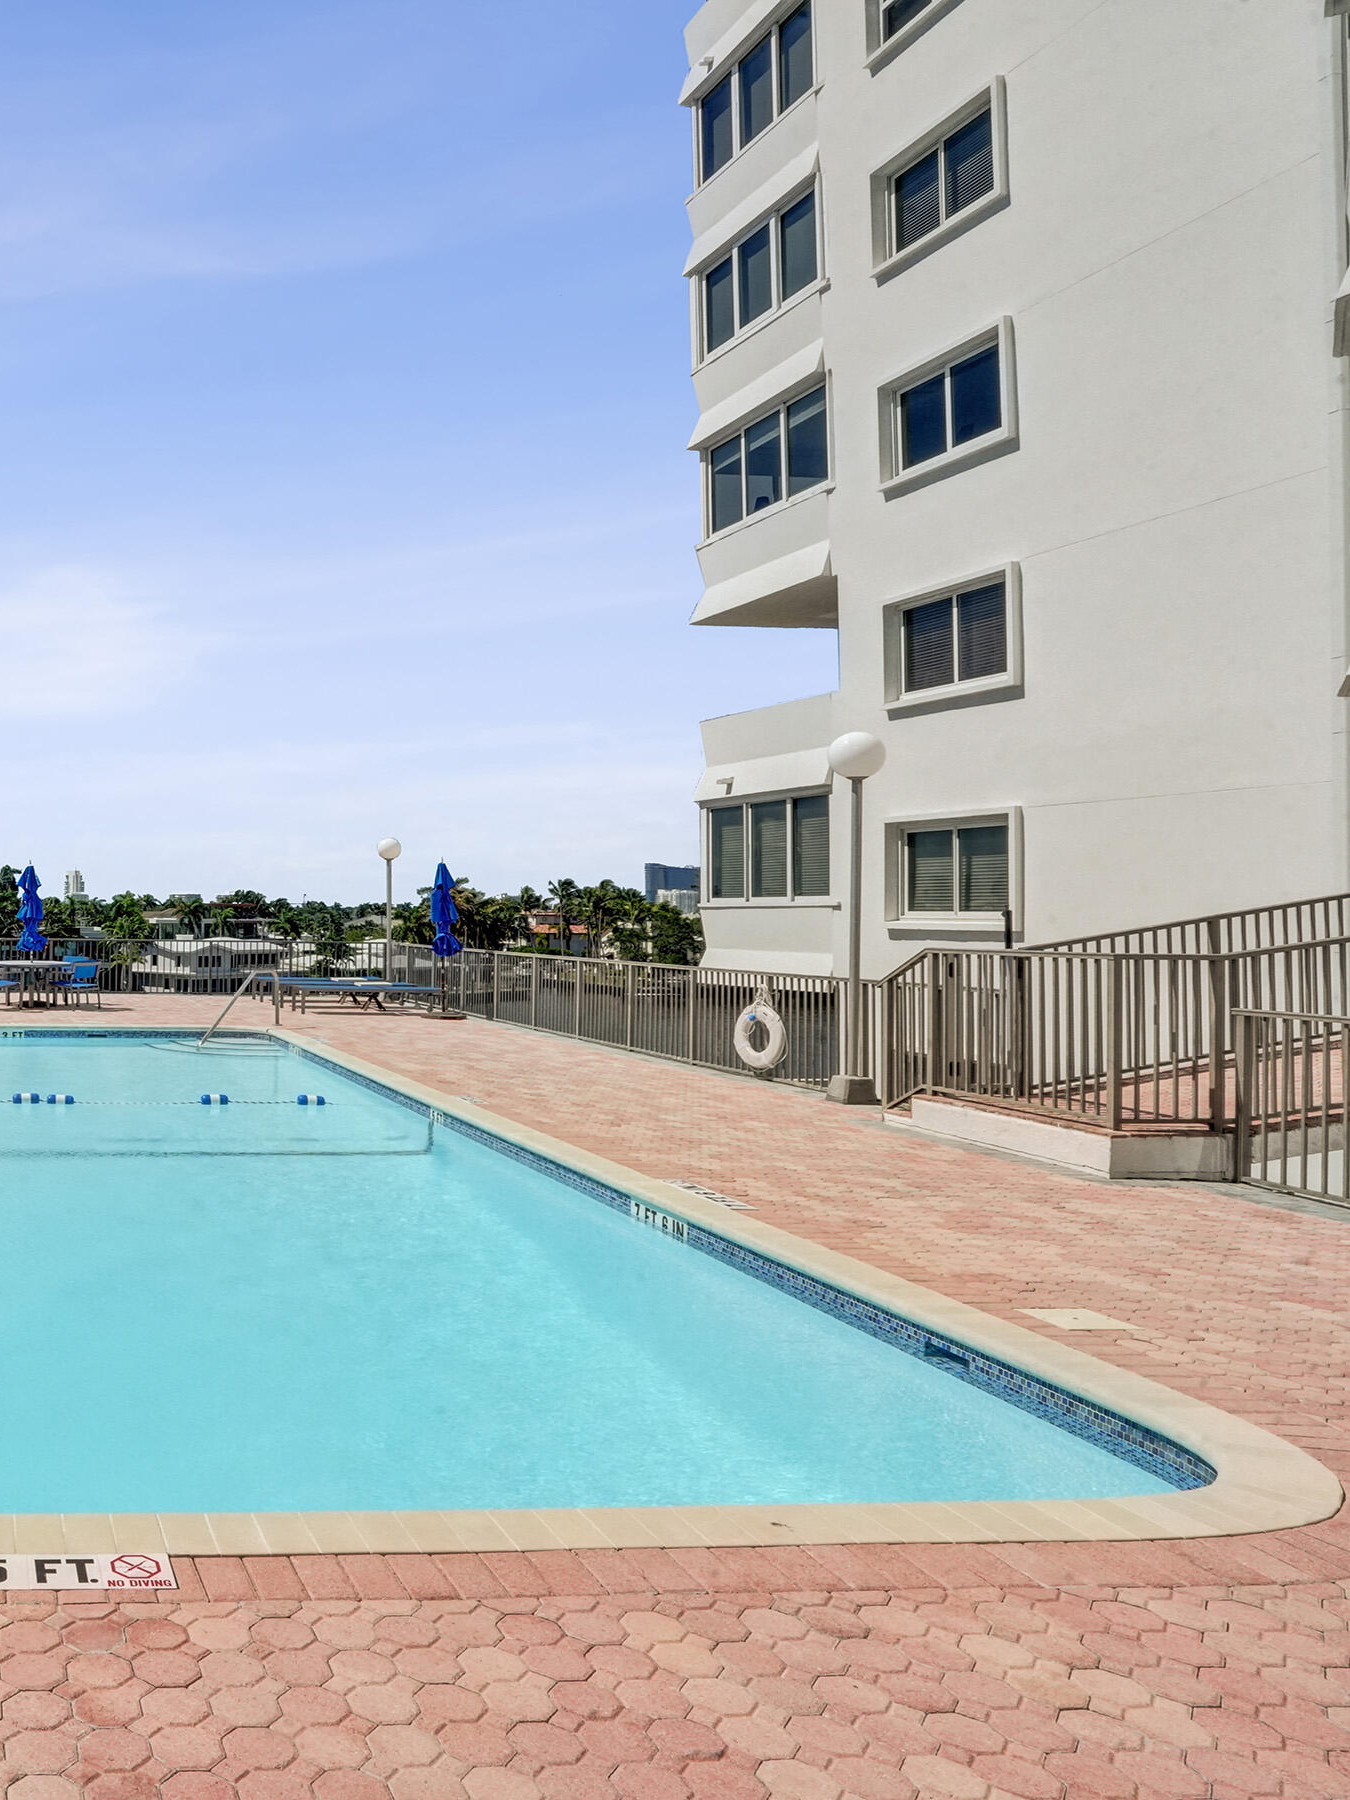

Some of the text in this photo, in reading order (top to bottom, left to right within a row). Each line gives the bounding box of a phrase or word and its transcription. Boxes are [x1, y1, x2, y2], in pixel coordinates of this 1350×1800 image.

[634, 1203, 684, 1238] 7 FT 6 IN
[34, 1558, 99, 1584] FT.
[107, 1579, 172, 1587] NO DIVING
